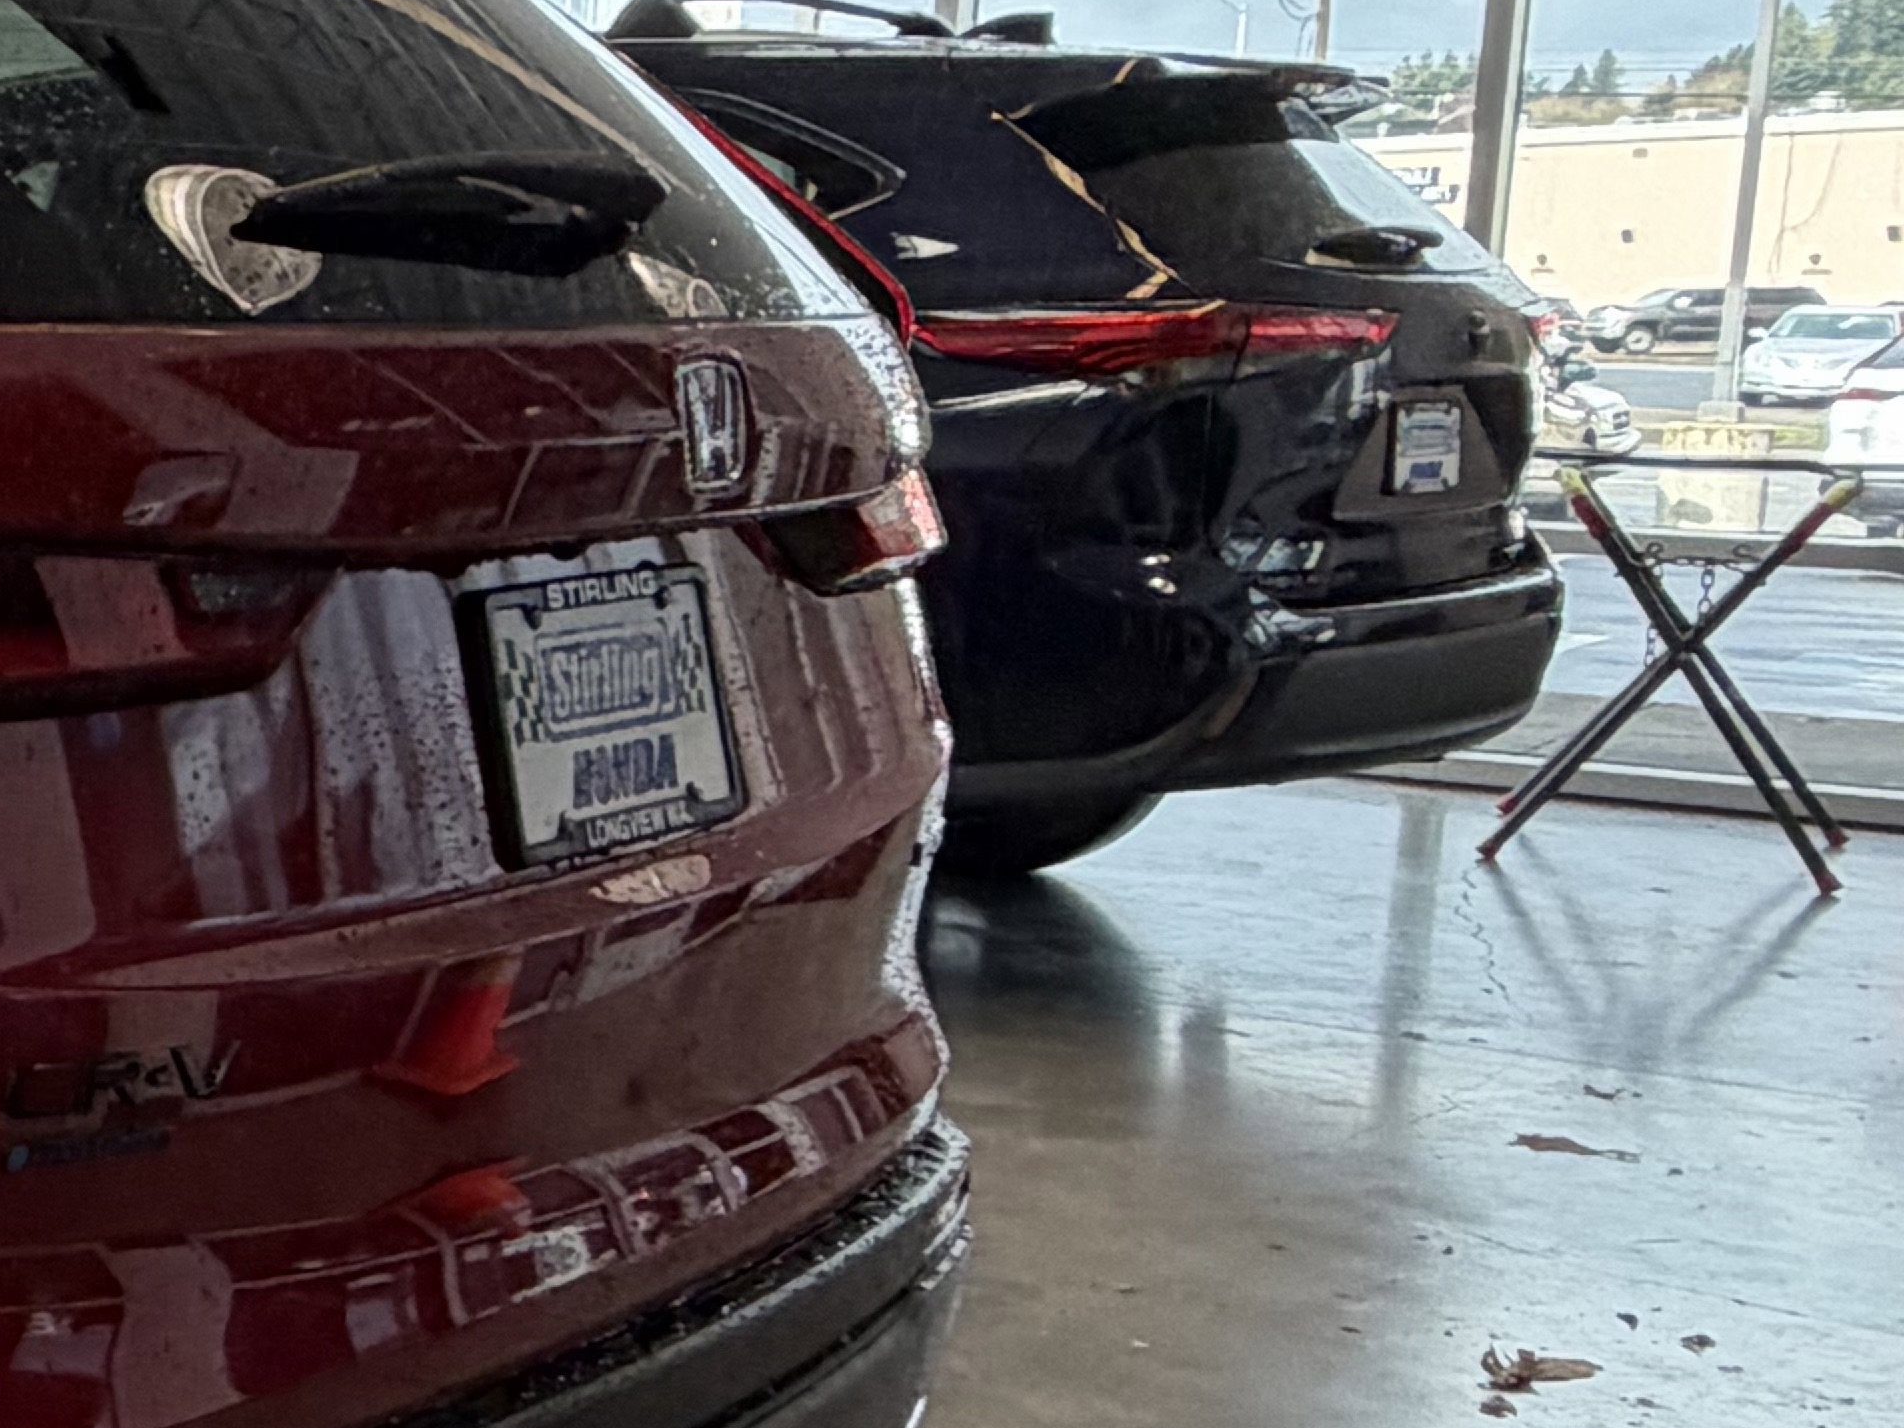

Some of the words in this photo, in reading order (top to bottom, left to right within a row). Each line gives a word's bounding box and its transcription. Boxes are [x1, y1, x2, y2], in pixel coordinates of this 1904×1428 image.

[546, 571, 658, 609] STIRLING
[549, 642, 660, 719] Stirling
[572, 733, 679, 810] HONDA
